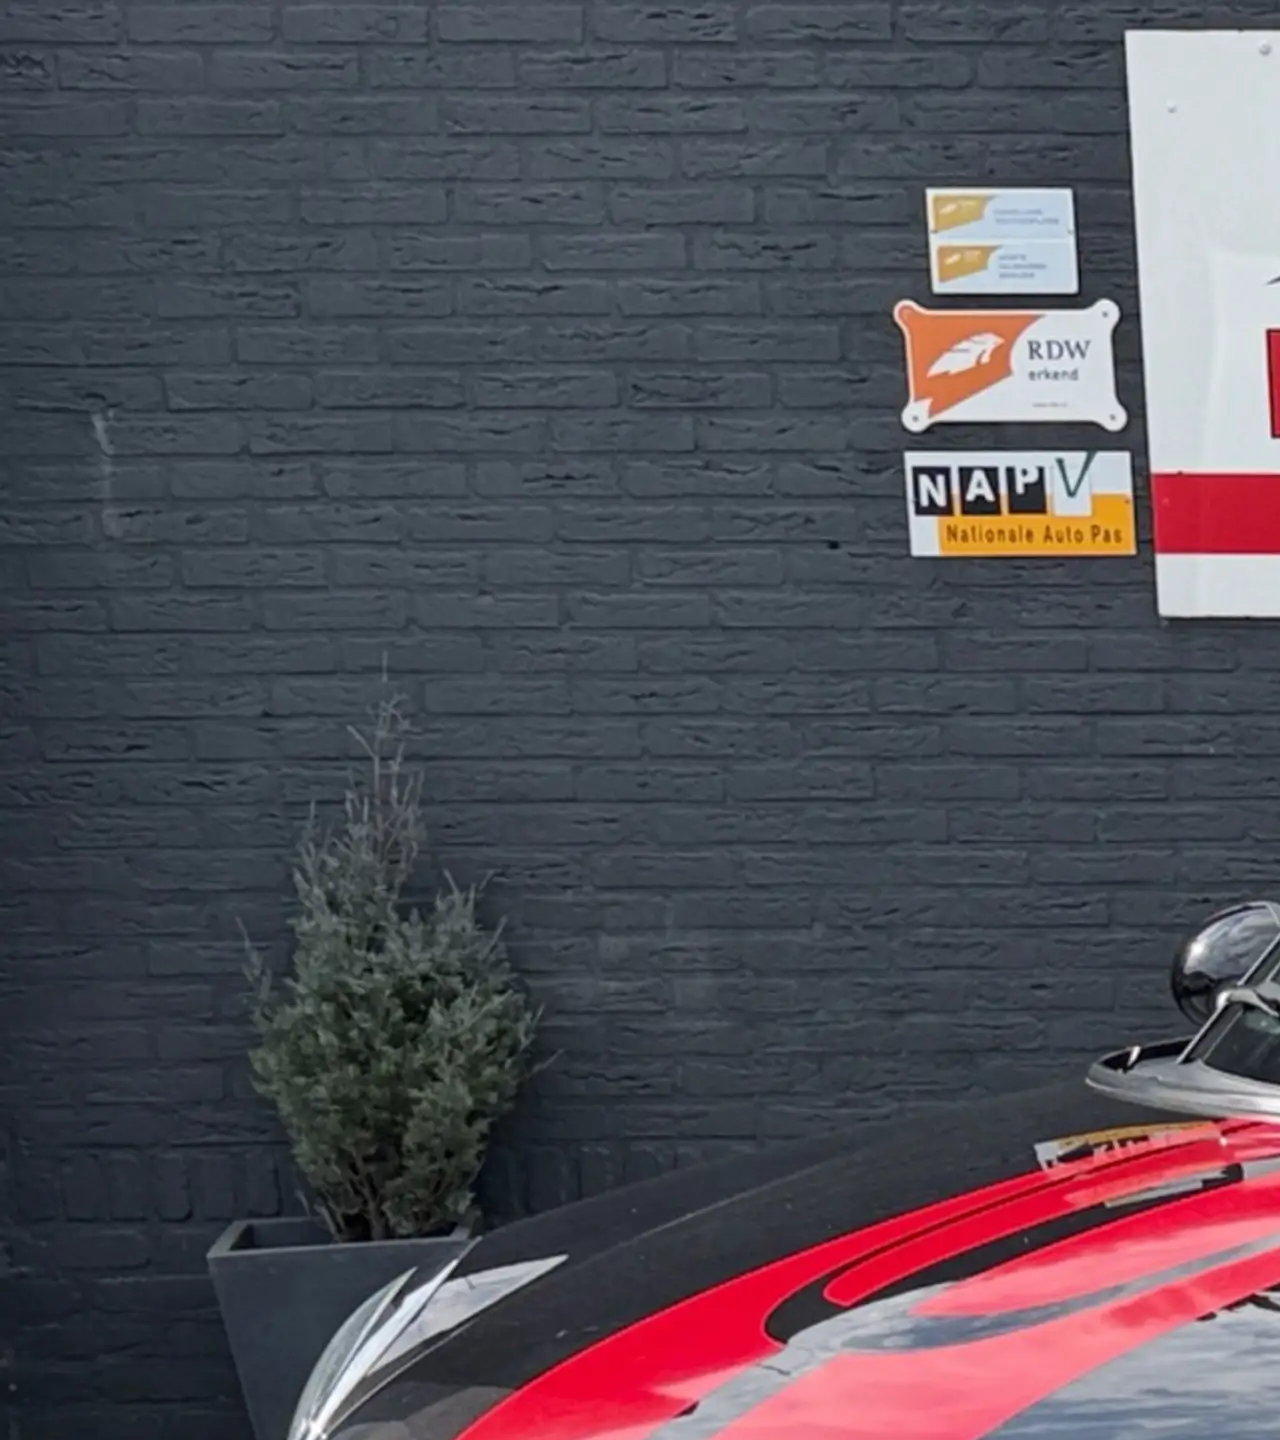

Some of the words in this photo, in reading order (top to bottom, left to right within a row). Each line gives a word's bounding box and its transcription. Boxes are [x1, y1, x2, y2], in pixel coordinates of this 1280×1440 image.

[1027, 340, 1092, 360] RDW
[1028, 366, 1079, 381] erkend
[946, 524, 1034, 544] Nationale
[1043, 524, 1084, 544] Auto
[1091, 523, 1123, 543] Pas
